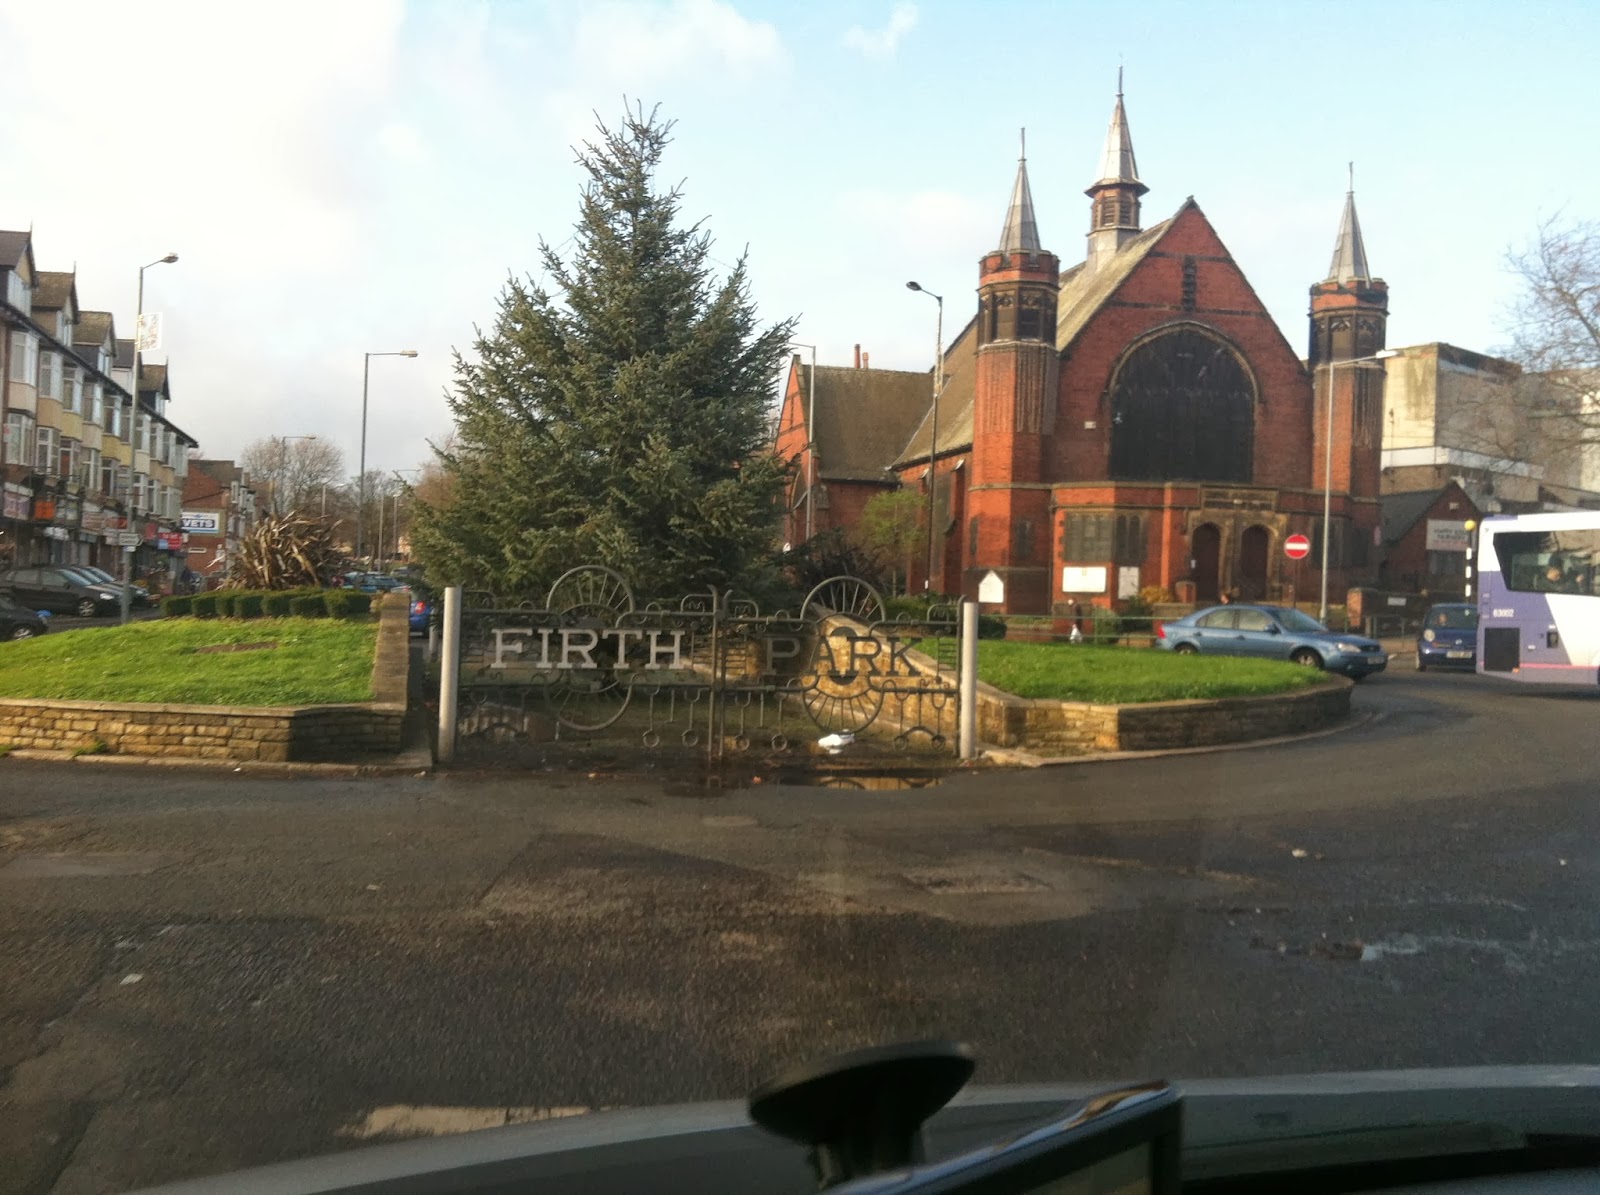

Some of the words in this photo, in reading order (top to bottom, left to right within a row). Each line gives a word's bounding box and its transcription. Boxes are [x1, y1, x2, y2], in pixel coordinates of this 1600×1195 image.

[182, 519, 214, 528] VETS
[491, 628, 686, 670] FIRTH
[765, 635, 923, 677] PARK
